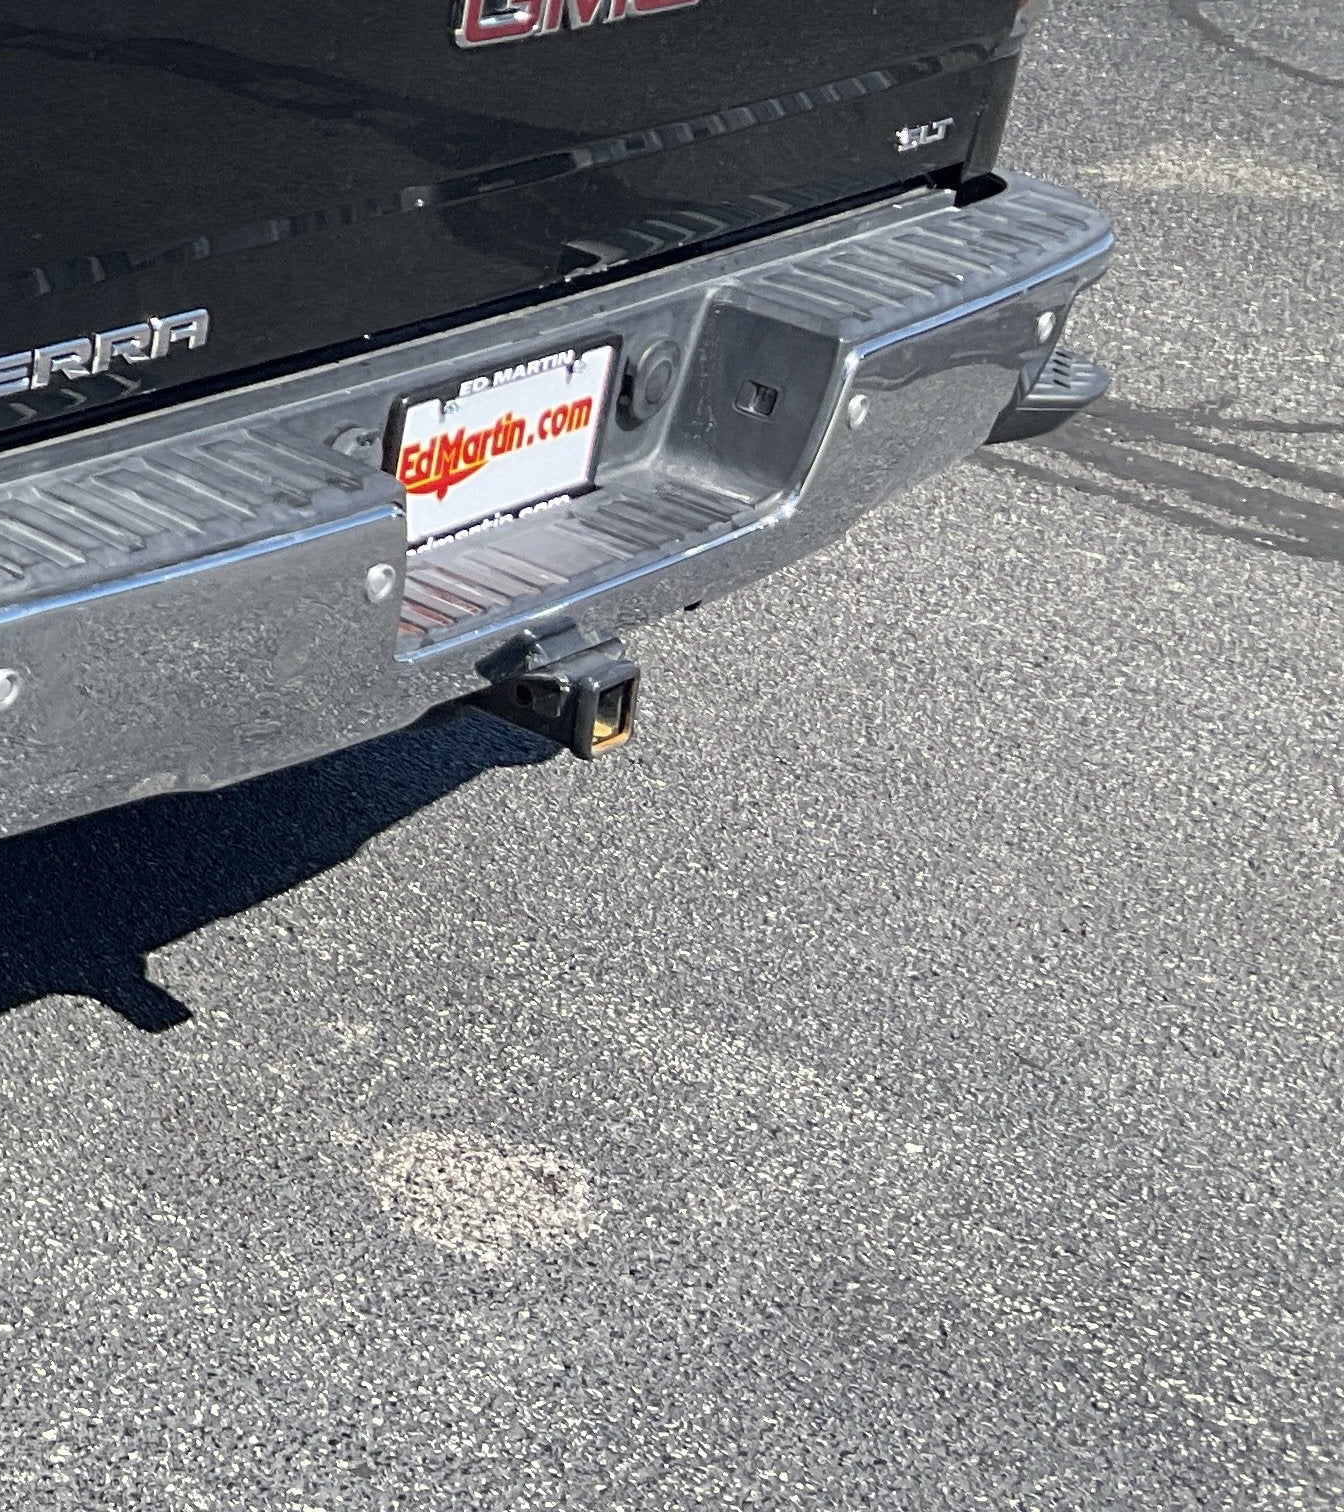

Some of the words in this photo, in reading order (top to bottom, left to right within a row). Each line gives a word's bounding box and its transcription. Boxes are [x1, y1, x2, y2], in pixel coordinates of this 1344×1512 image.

[459, 375, 490, 397] ED
[493, 349, 575, 387] MARTIN
[398, 395, 593, 483] EdMartin.com
